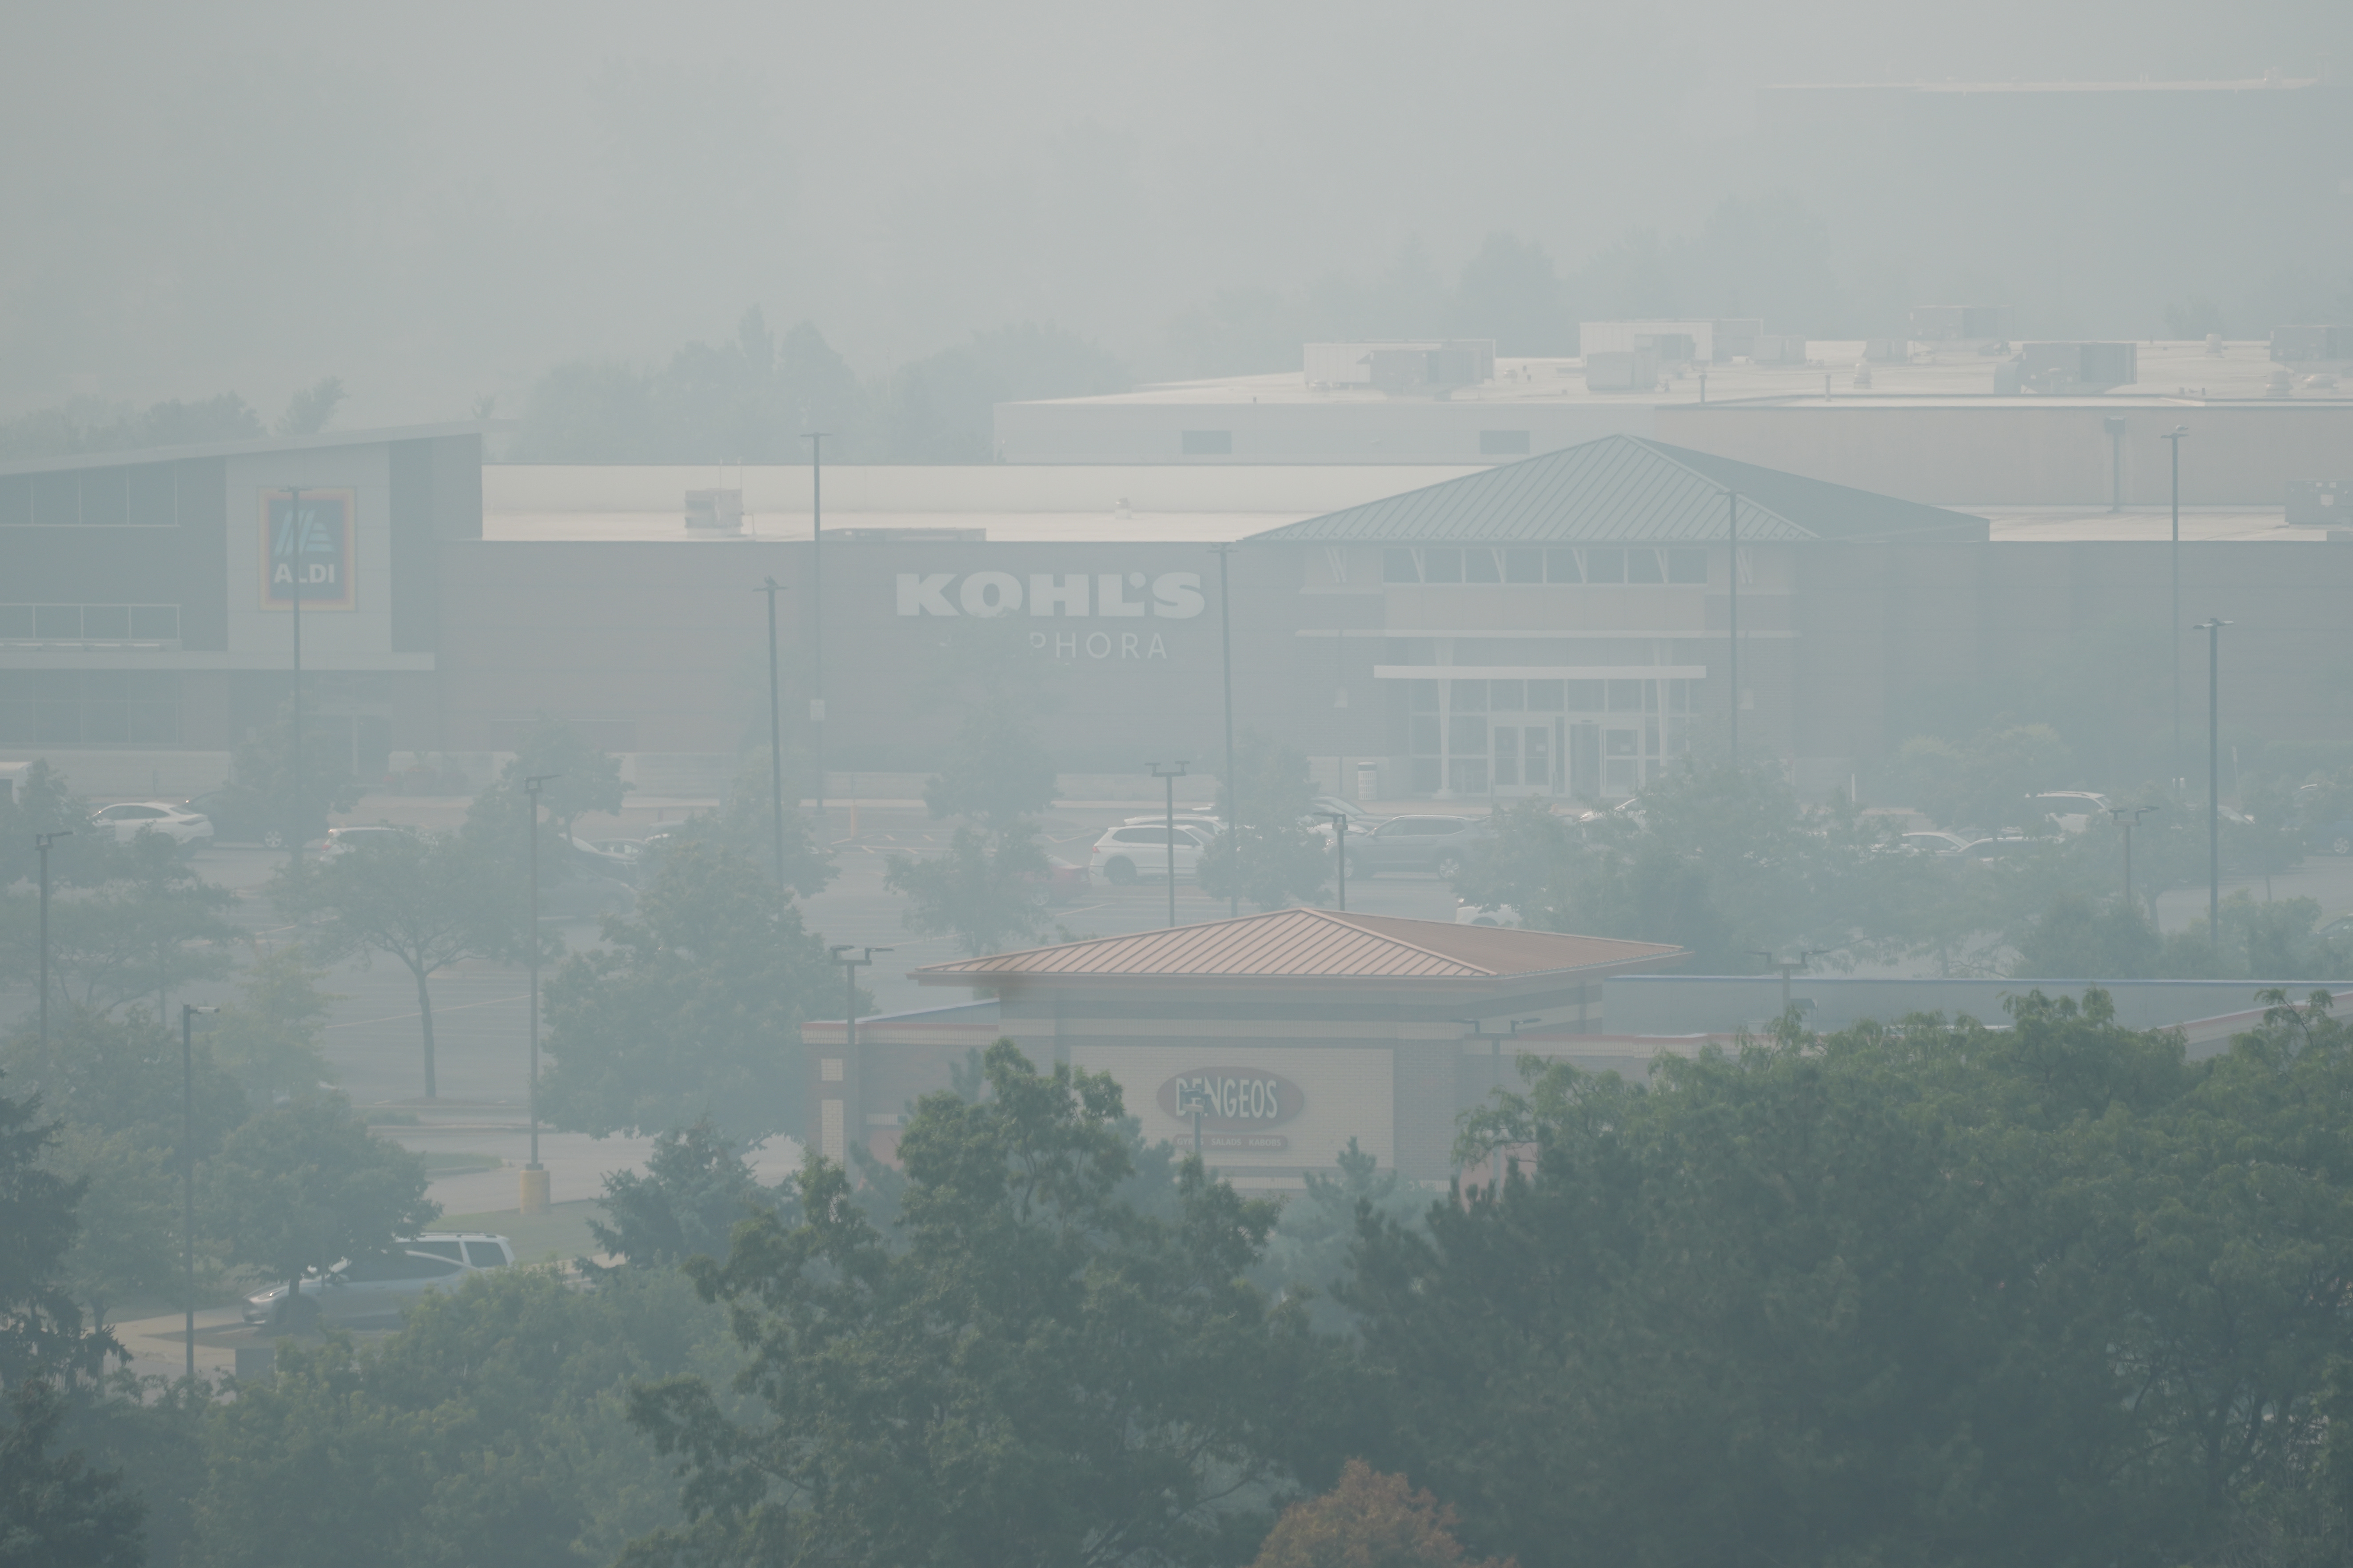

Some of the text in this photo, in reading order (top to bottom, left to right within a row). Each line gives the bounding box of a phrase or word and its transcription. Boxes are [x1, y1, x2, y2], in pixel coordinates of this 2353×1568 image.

[274, 563, 335, 584] ADI
[896, 571, 1205, 619] KOHL'S
[1005, 632, 1168, 659] PHORA
[1177, 1138, 1204, 1146] GYRS
